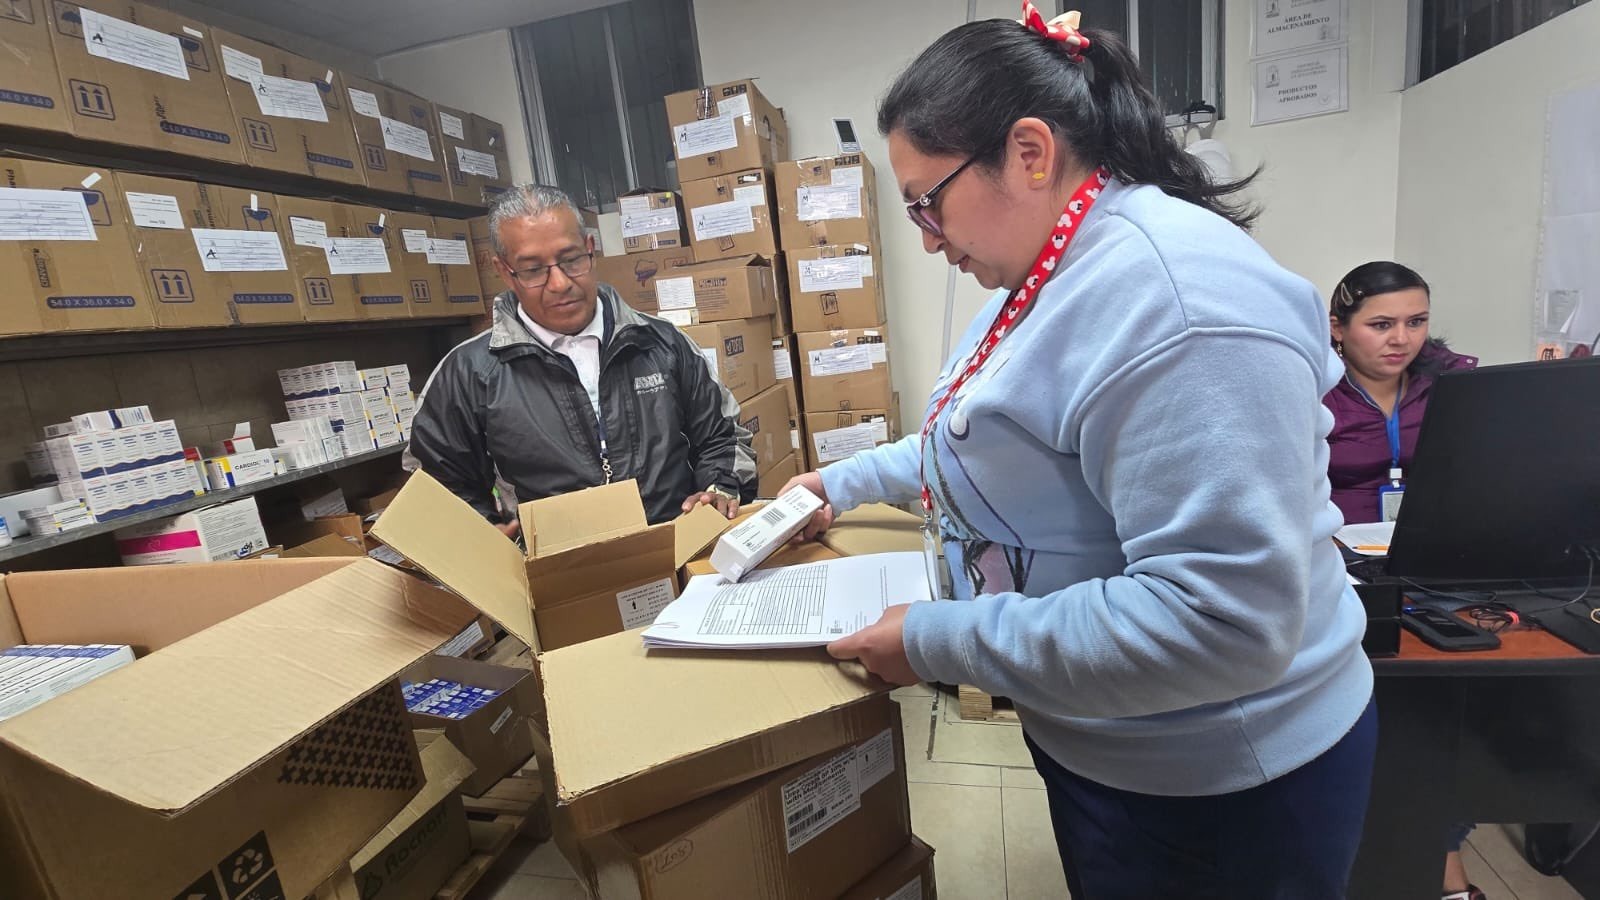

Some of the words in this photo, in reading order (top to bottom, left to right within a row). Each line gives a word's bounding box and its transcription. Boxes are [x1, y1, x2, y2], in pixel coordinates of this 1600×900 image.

[1267, 16, 1331, 34] ALMACENAMIENTO
[1278, 84, 1318, 96] PRODUCTOS
[1278, 92, 1318, 103] APROBADOS
